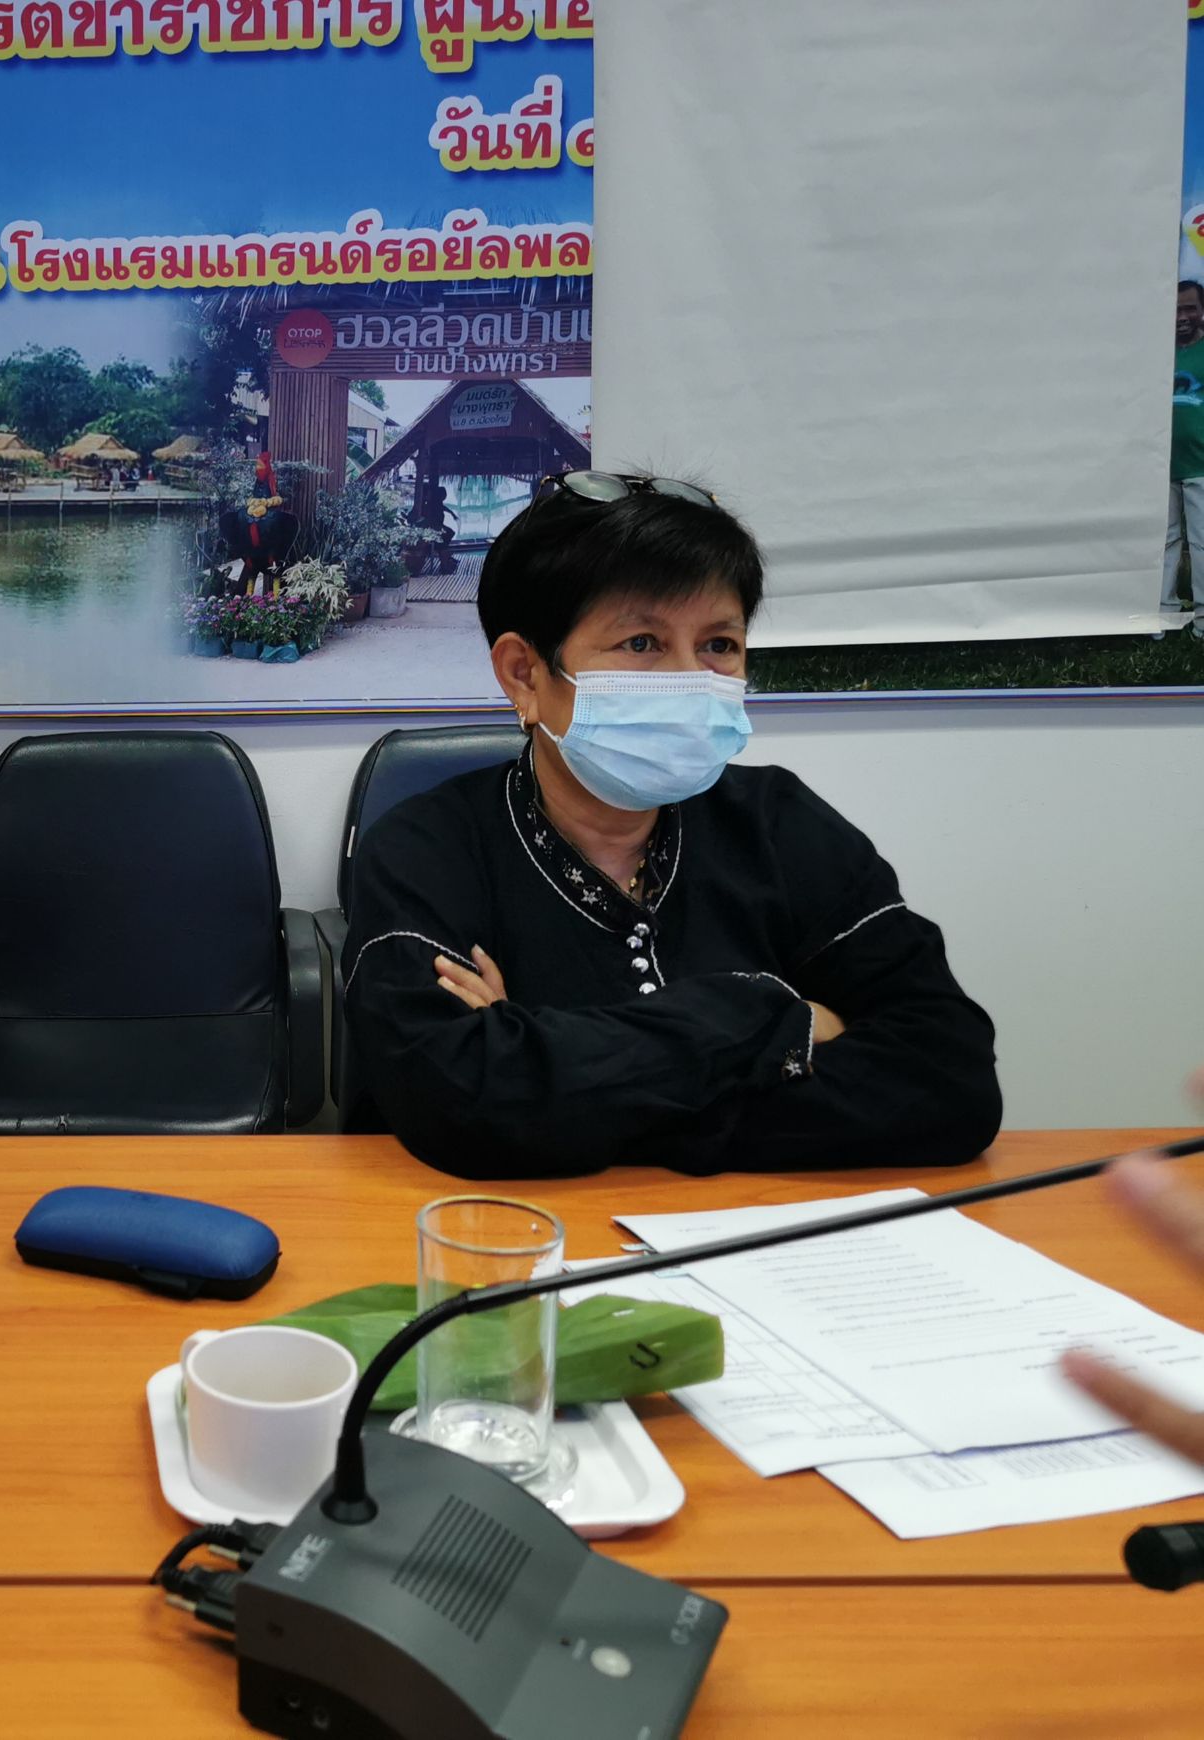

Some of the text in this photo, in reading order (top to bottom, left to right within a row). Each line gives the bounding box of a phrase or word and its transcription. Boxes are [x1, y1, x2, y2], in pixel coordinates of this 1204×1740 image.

[438, 85, 553, 162] วันที่
[287, 327, 323, 338] OTOP
